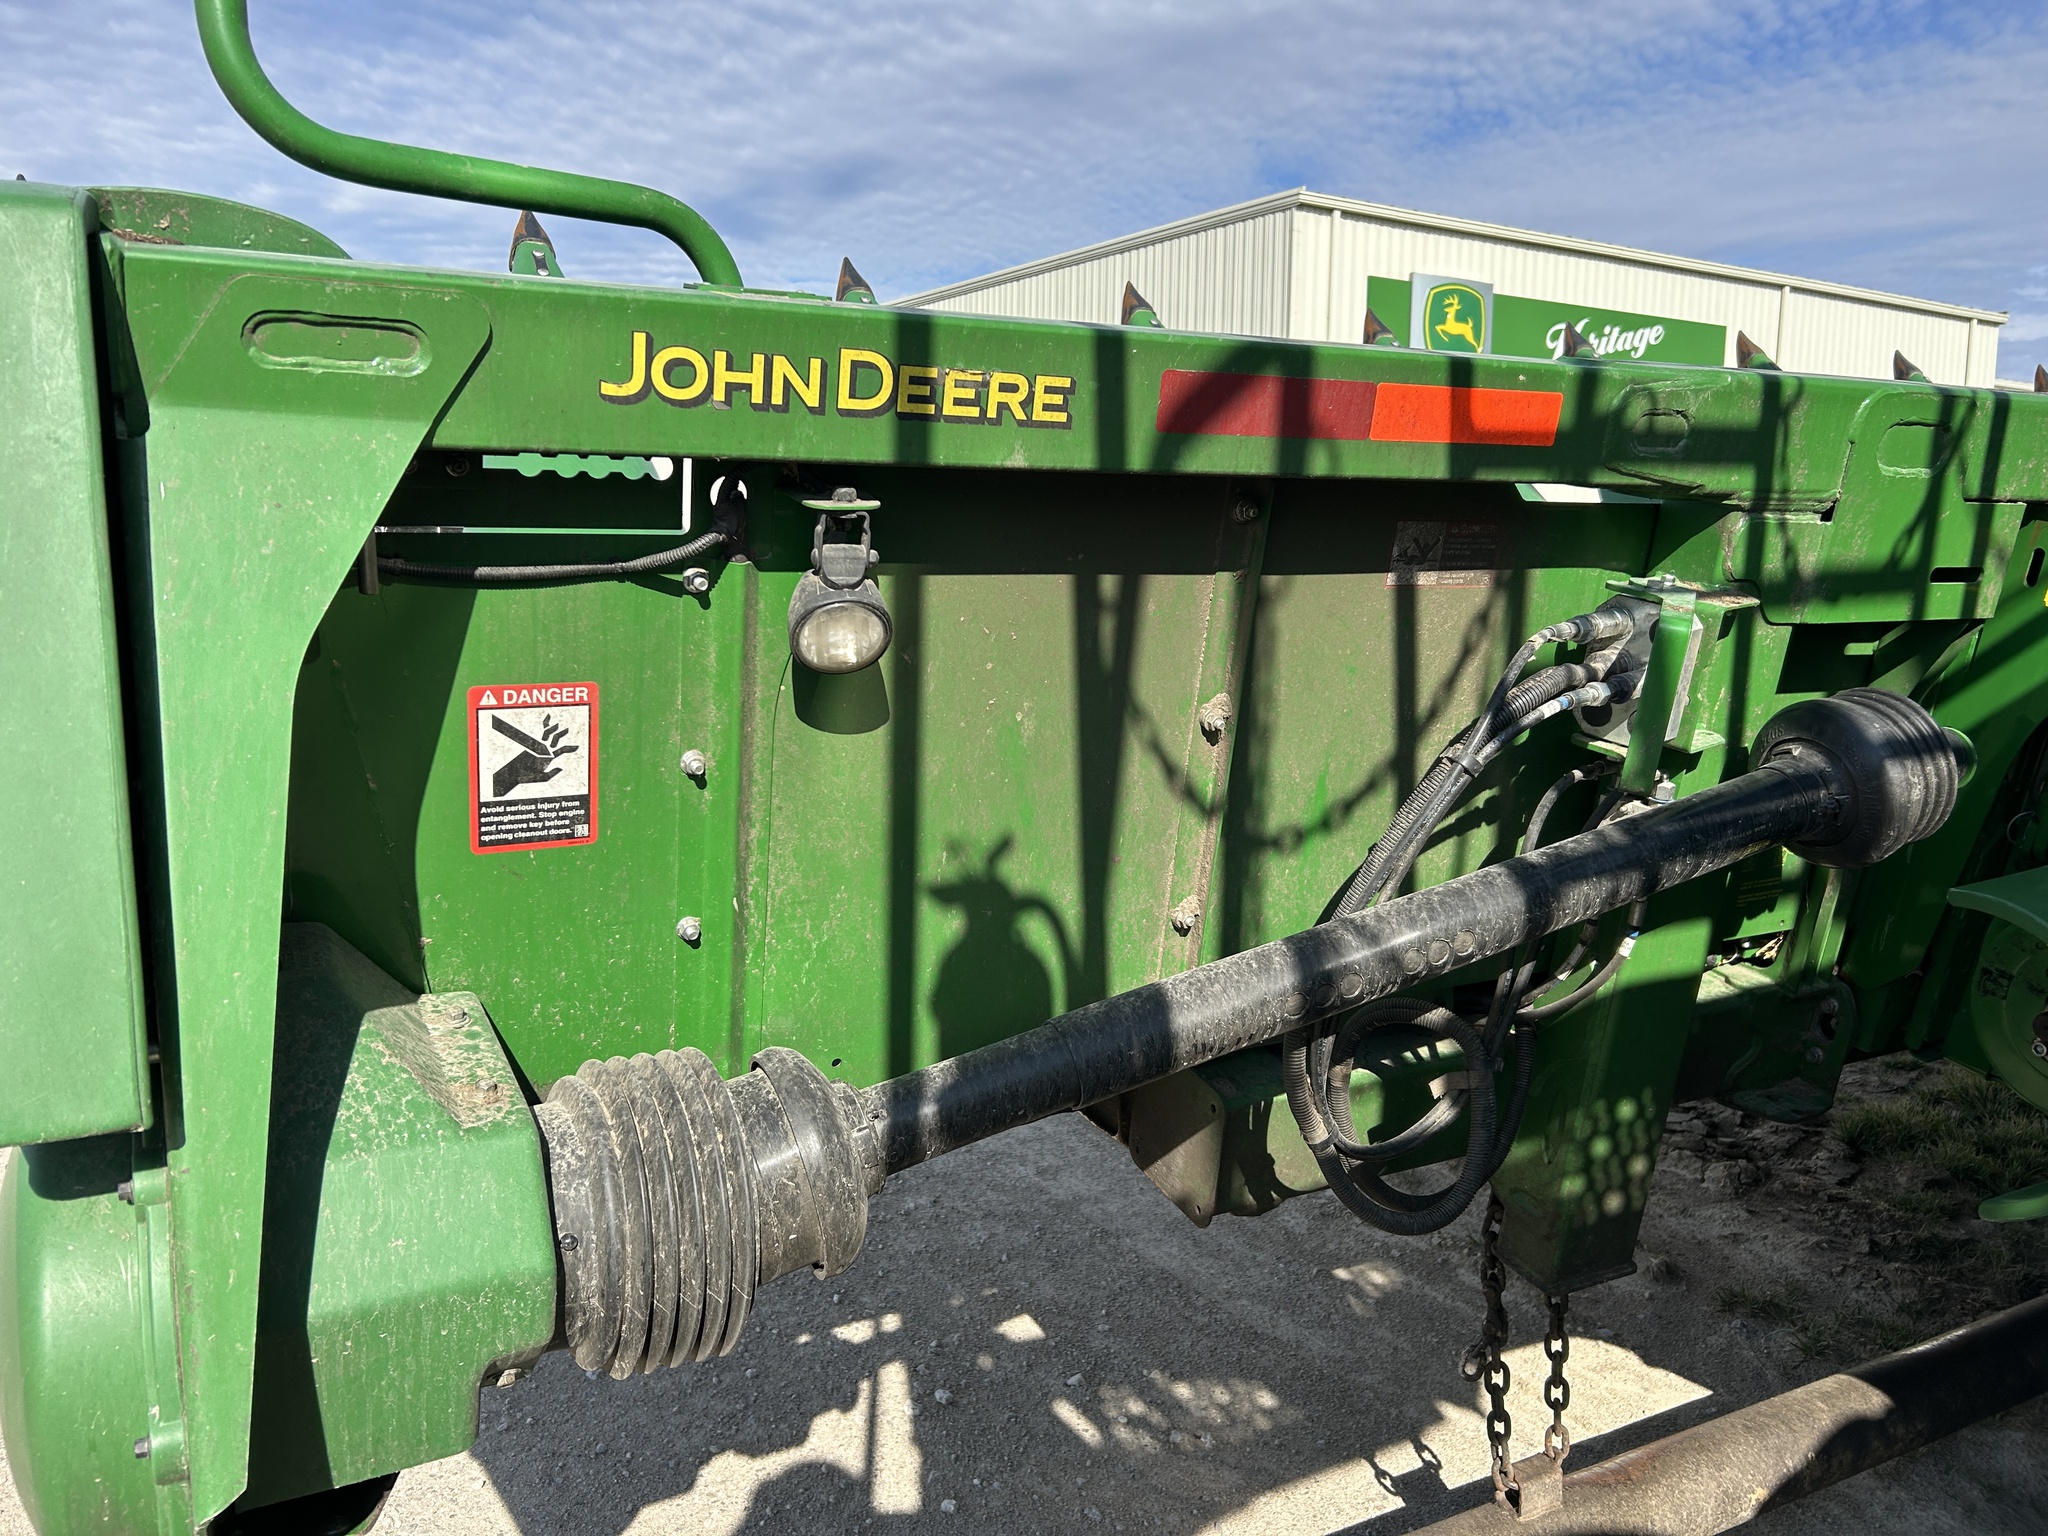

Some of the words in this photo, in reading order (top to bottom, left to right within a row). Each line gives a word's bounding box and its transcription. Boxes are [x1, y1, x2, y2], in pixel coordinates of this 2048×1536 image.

[1545, 316, 1664, 360] Hritage
[599, 331, 826, 414] JOHN
[837, 347, 1075, 428] DEERE
[503, 687, 589, 705] DANGER
[480, 806, 504, 814] Avoid
[537, 802, 560, 810] injury
[480, 813, 537, 822] entanglement.
[538, 811, 558, 820] Stop
[558, 809, 585, 817] engine
[529, 821, 543, 829] key
[480, 832, 513, 842] opening
[514, 829, 548, 838] cleanout
[549, 827, 573, 835] doors.
